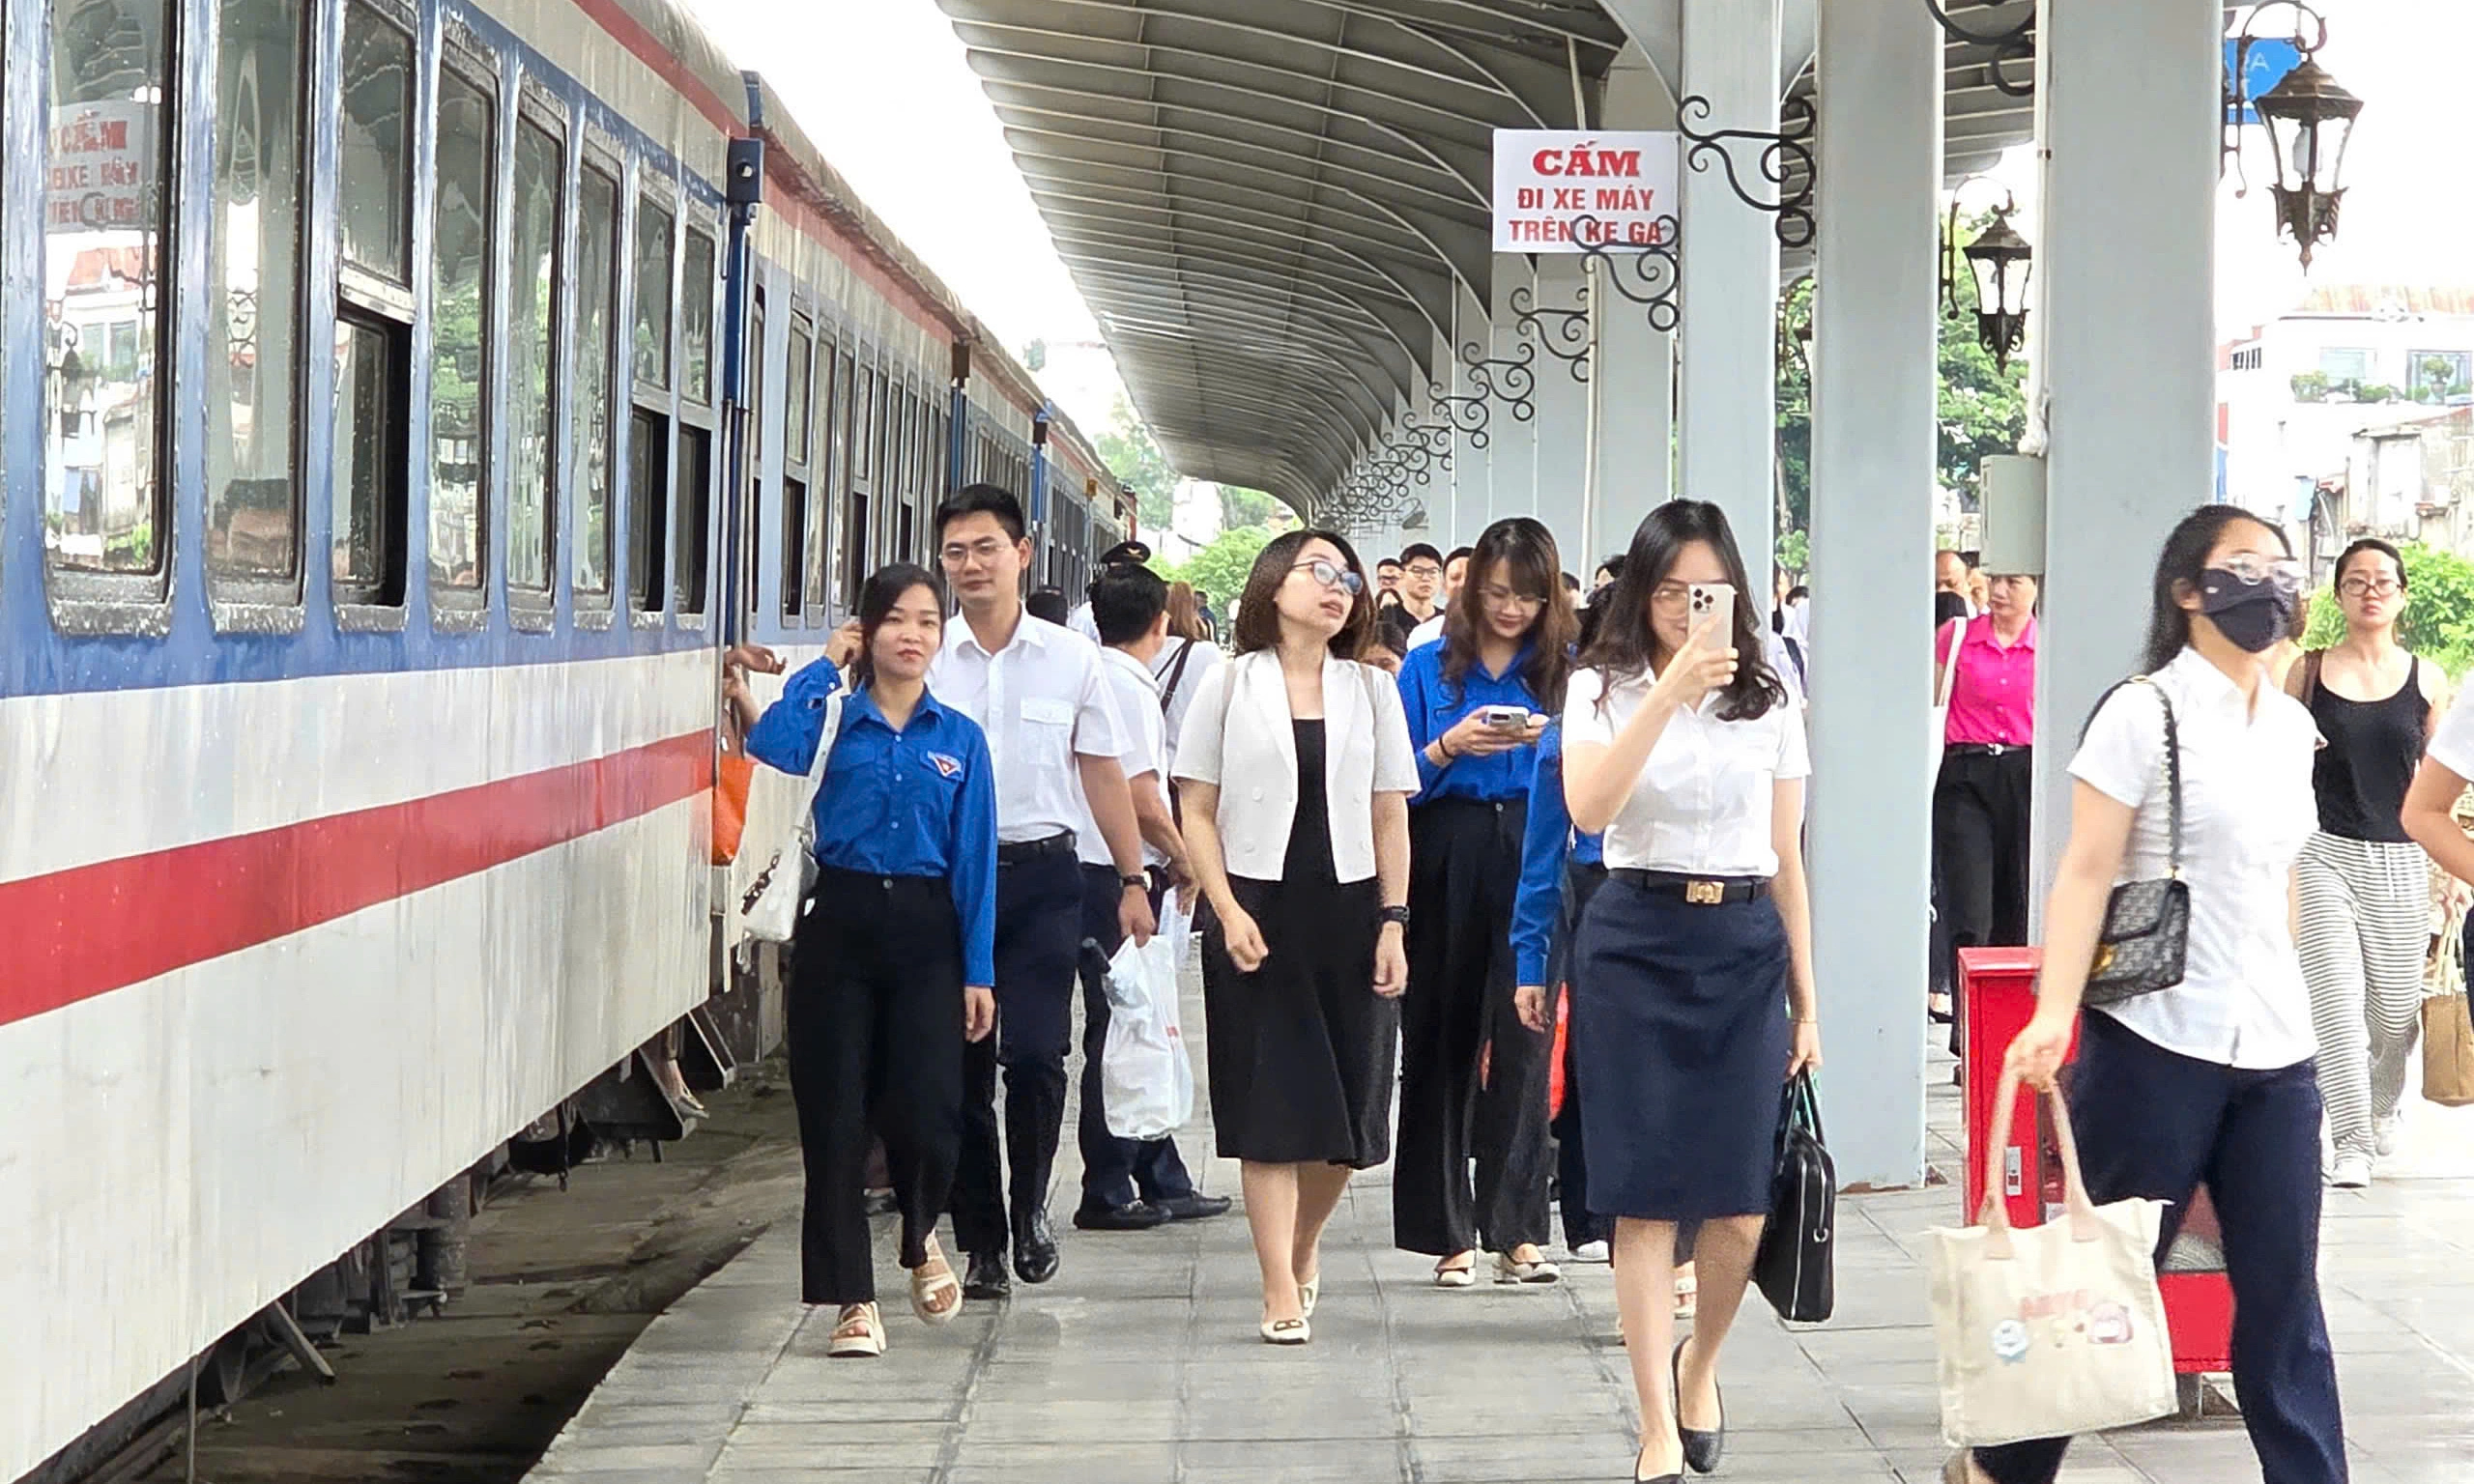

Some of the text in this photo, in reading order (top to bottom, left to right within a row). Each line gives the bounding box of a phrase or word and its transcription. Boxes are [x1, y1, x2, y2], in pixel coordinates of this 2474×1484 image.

[1533, 141, 1641, 177] CẤM
[1517, 185, 1654, 211] ĐI XE MÁY
[1509, 216, 1662, 244] TRÊN KE GA
